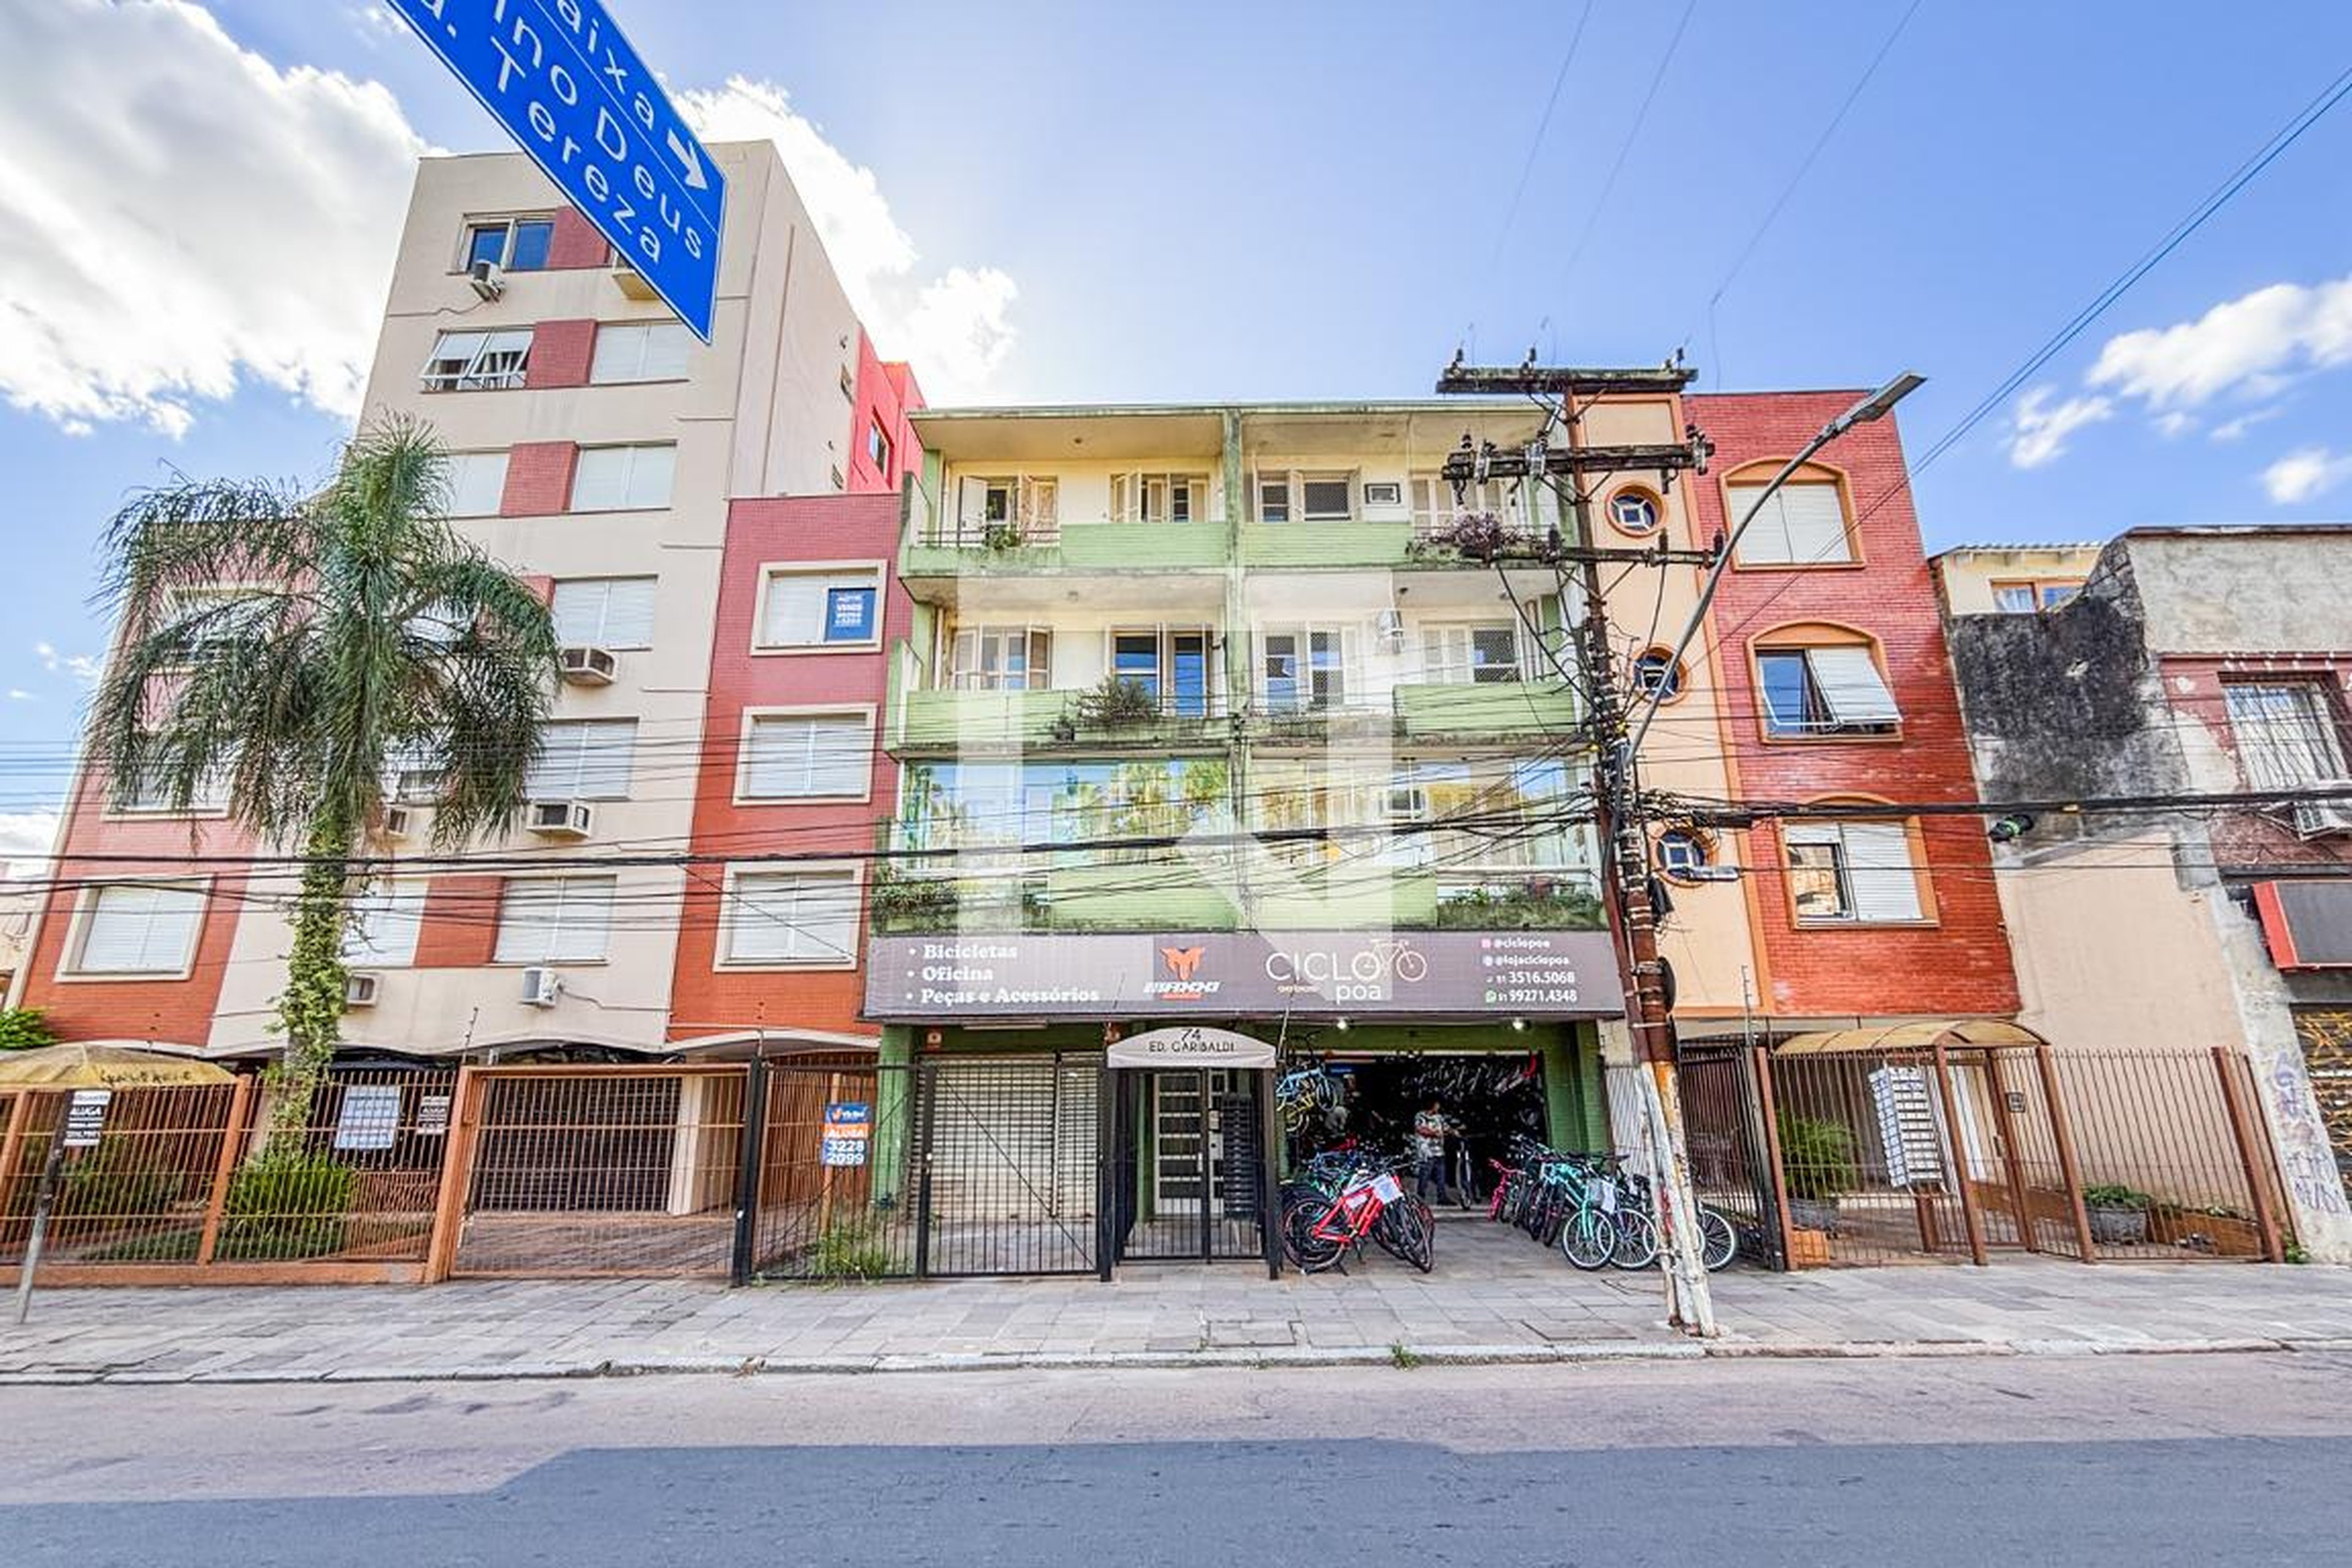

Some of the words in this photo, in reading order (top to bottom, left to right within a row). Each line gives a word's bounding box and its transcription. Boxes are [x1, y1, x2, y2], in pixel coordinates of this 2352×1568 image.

[491, 36, 661, 264] Tereza
[596, 107, 702, 260] Deus
[1493, 937, 1551, 950] @ciclopoa
[923, 944, 1018, 959] Bicicletas
[1265, 951, 1381, 981] CICLO
[1494, 954, 1570, 967] @lojaciclopoa
[922, 965, 993, 981] Oficina
[1508, 971, 1575, 984] 3516.5068
[921, 988, 974, 1006] Peças
[978, 991, 990, 1003] e
[994, 986, 1100, 1003] Acessórios
[1336, 984, 1382, 1005] poa
[1181, 1028, 1201, 1041] 74
[1171, 1041, 1235, 1053] GARIBALDI
[827, 1139, 865, 1152] 3228
[826, 1153, 865, 1166] 2099
